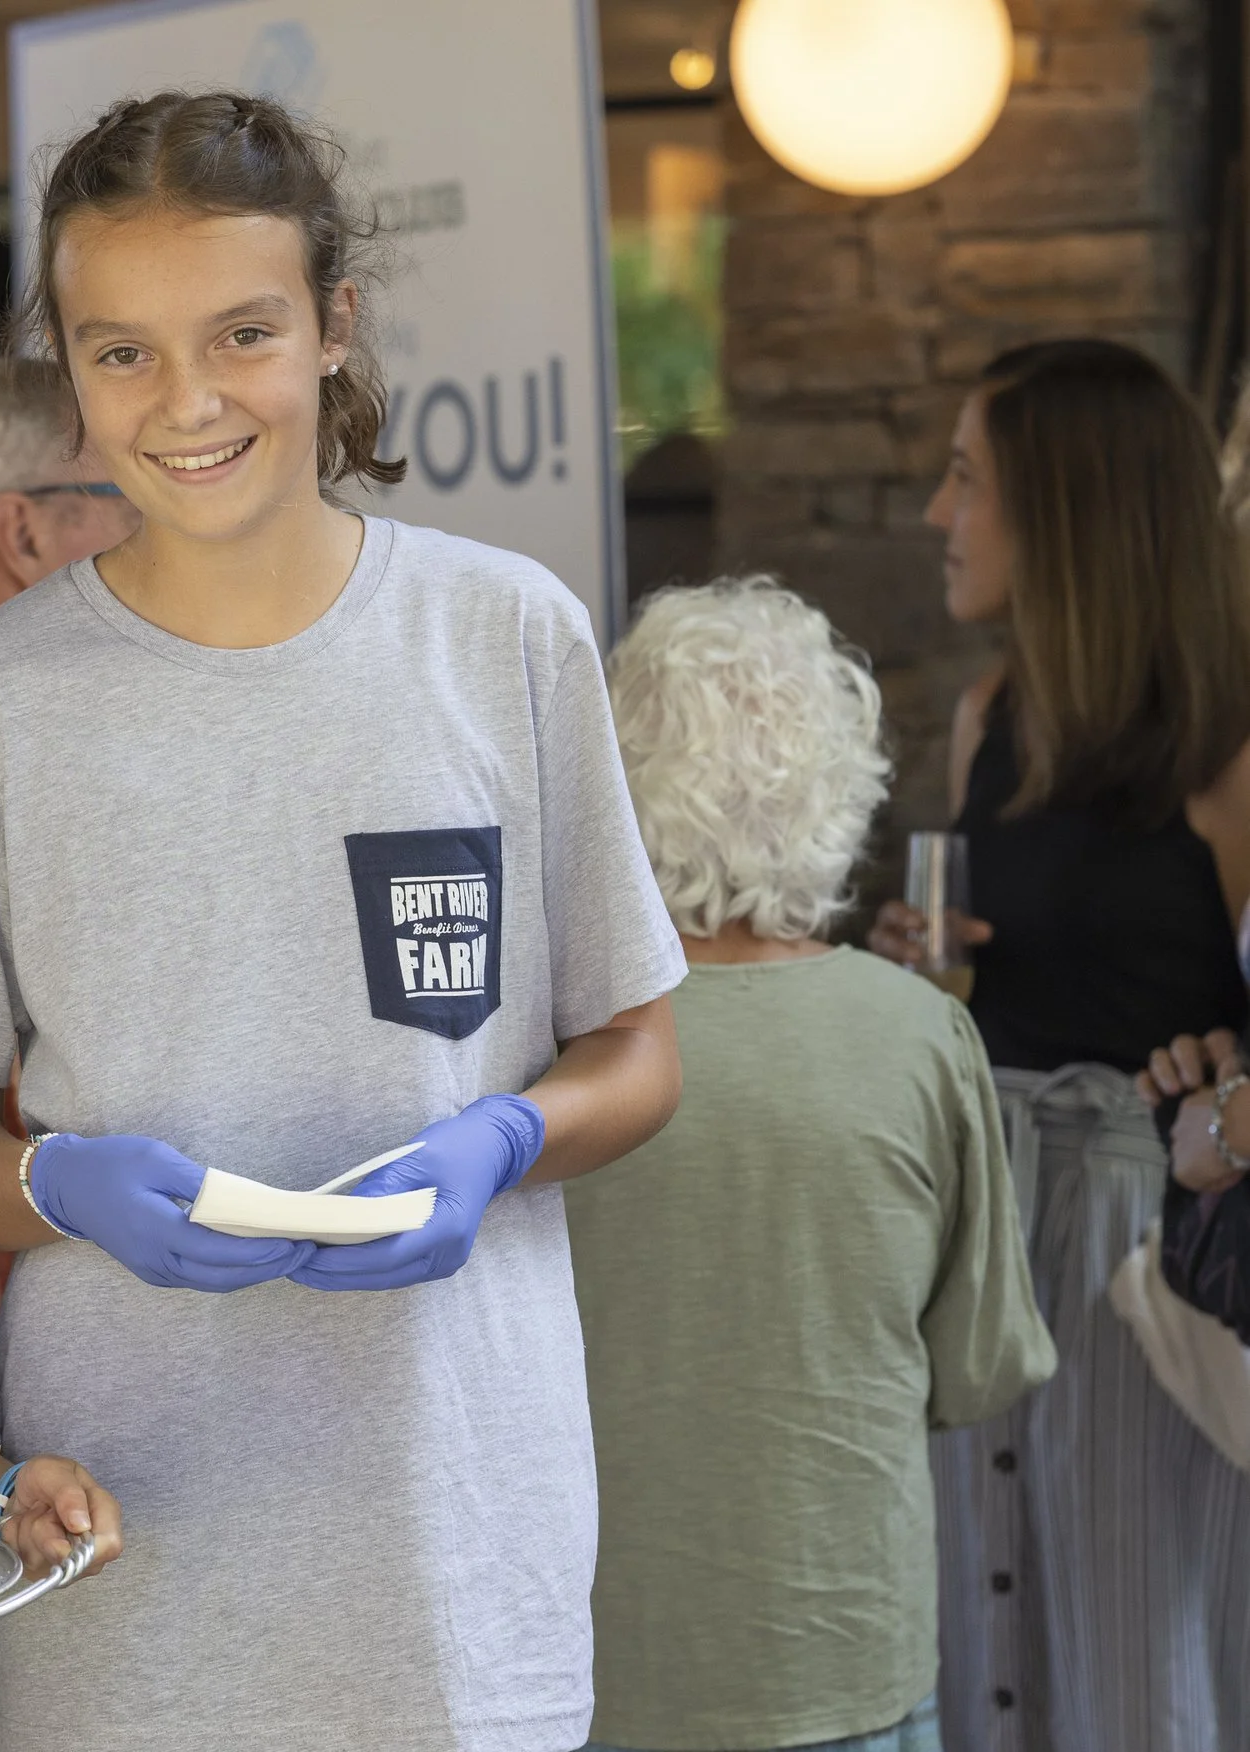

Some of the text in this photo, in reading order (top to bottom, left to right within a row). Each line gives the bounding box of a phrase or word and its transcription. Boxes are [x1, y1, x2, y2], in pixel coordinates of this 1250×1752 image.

[391, 881, 488, 926] BENT RIVER
[413, 922, 452, 937] Benefit
